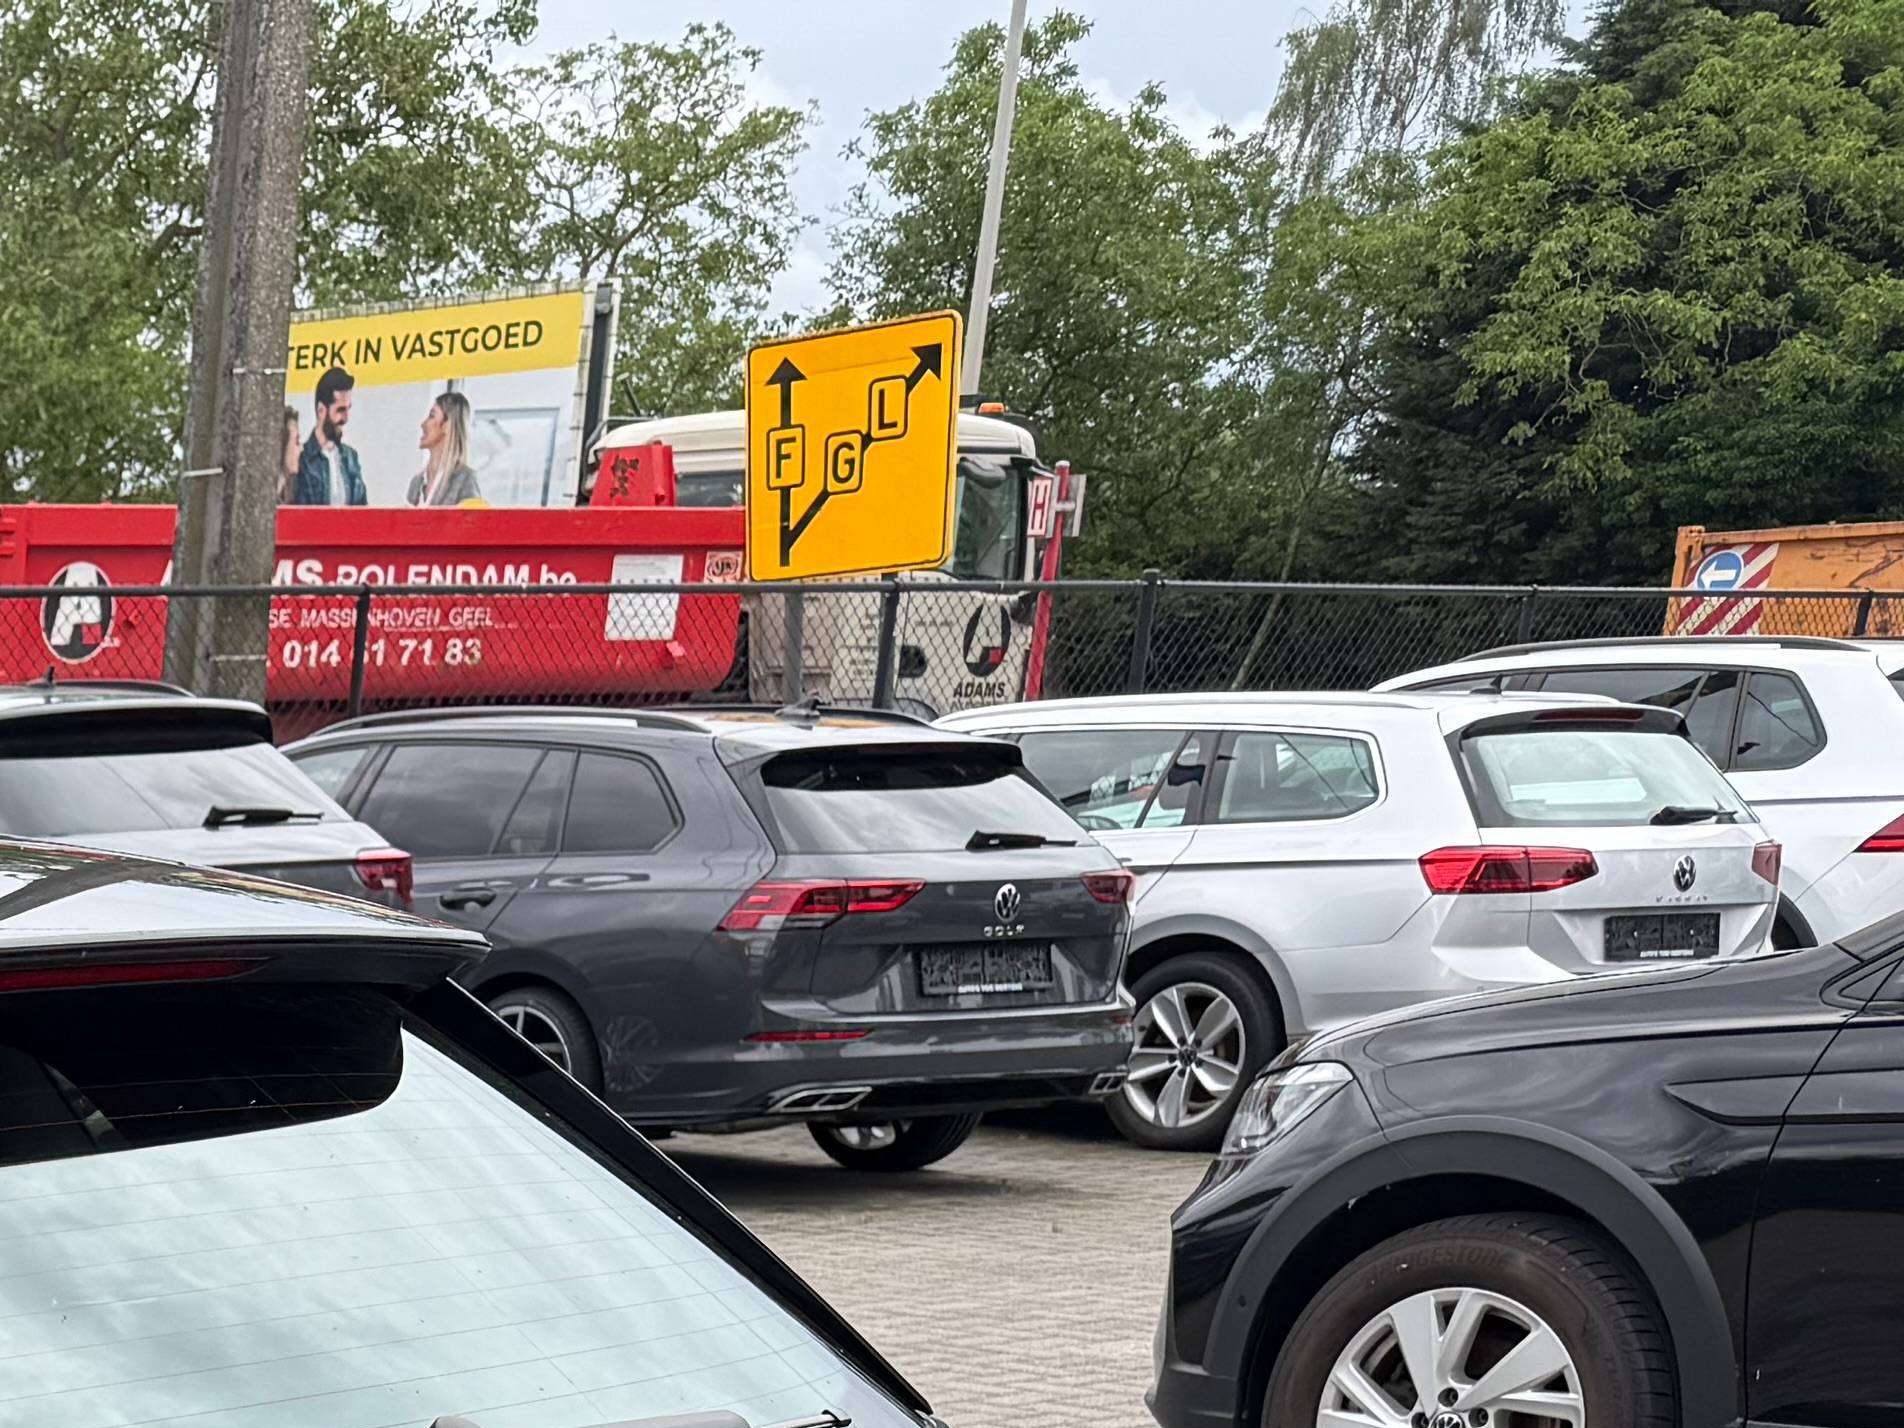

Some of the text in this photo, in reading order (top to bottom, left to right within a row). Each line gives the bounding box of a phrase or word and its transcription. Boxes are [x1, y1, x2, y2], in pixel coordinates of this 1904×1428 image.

[355, 336, 382, 364] IN
[391, 320, 542, 360] VASTGOED
[877, 388, 898, 430] L
[775, 436, 797, 480] F
[831, 442, 856, 483] G
[281, 638, 341, 669] 014
[399, 638, 433, 667] 71
[445, 637, 482, 667] 83
[953, 682, 1006, 699] ADAMS
